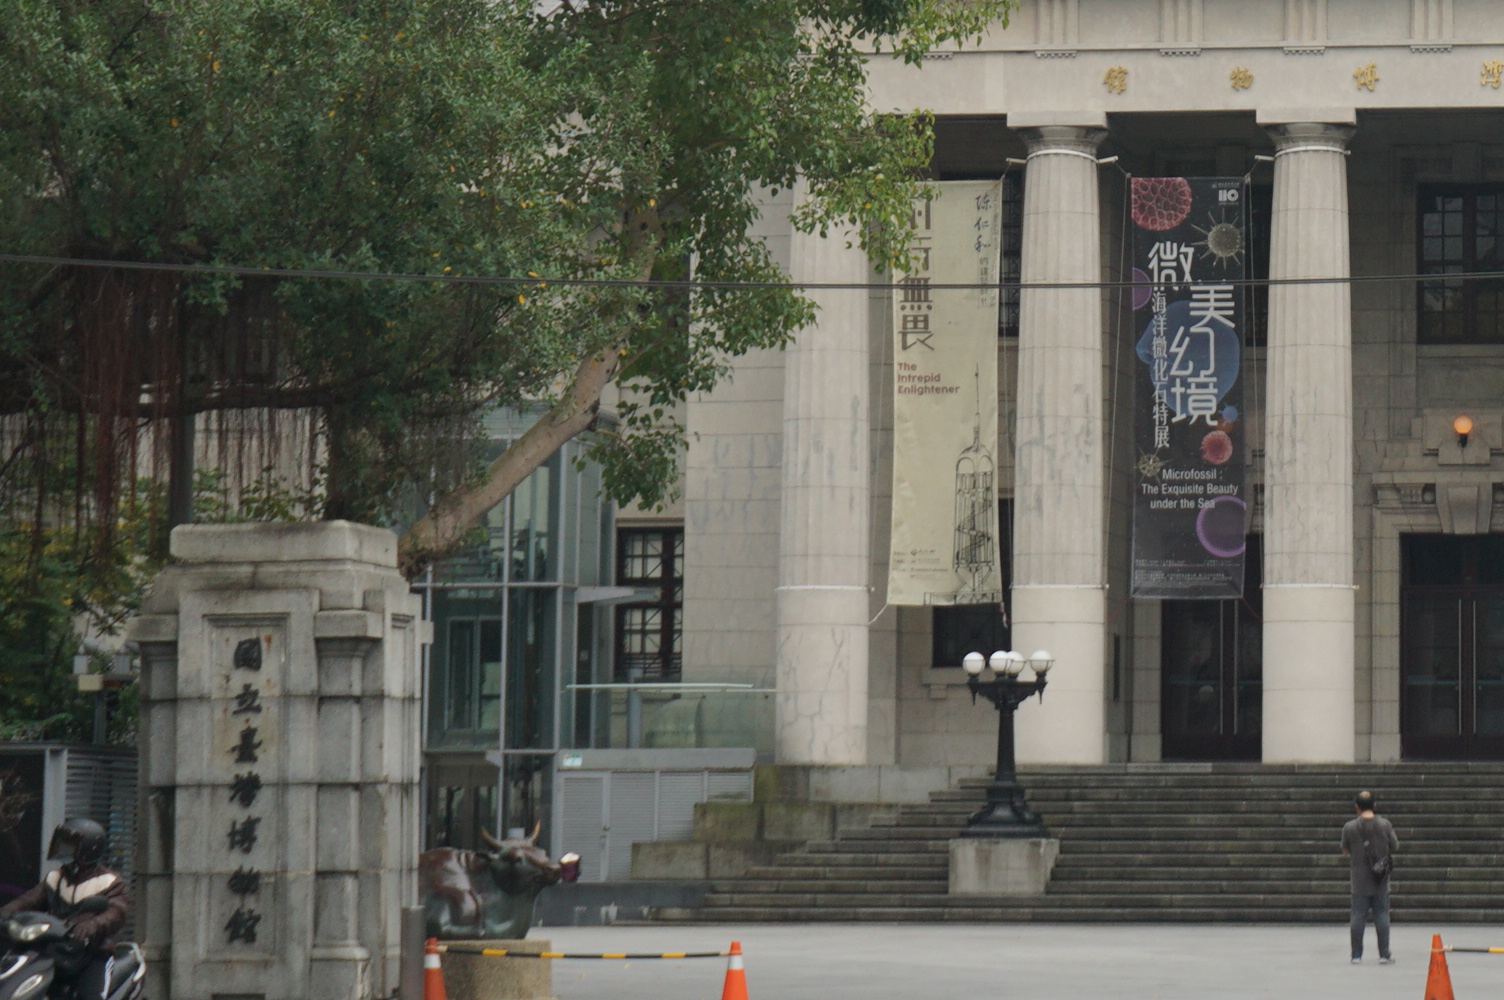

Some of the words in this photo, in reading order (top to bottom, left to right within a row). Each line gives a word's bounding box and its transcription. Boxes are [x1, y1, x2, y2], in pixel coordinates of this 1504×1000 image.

[897, 362, 918, 371] The
[1151, 291, 1171, 449] 海洋微化石特展
[897, 373, 941, 383] Intrepid
[897, 384, 961, 396] Enlightener
[1162, 468, 1217, 480] Microfossil
[1141, 483, 1159, 495] The
[1161, 483, 1205, 496] Exquisite
[1206, 482, 1239, 496] Beauty
[1150, 498, 1178, 509] under
[1180, 498, 1196, 509] the
[1198, 498, 1216, 509] Sea
